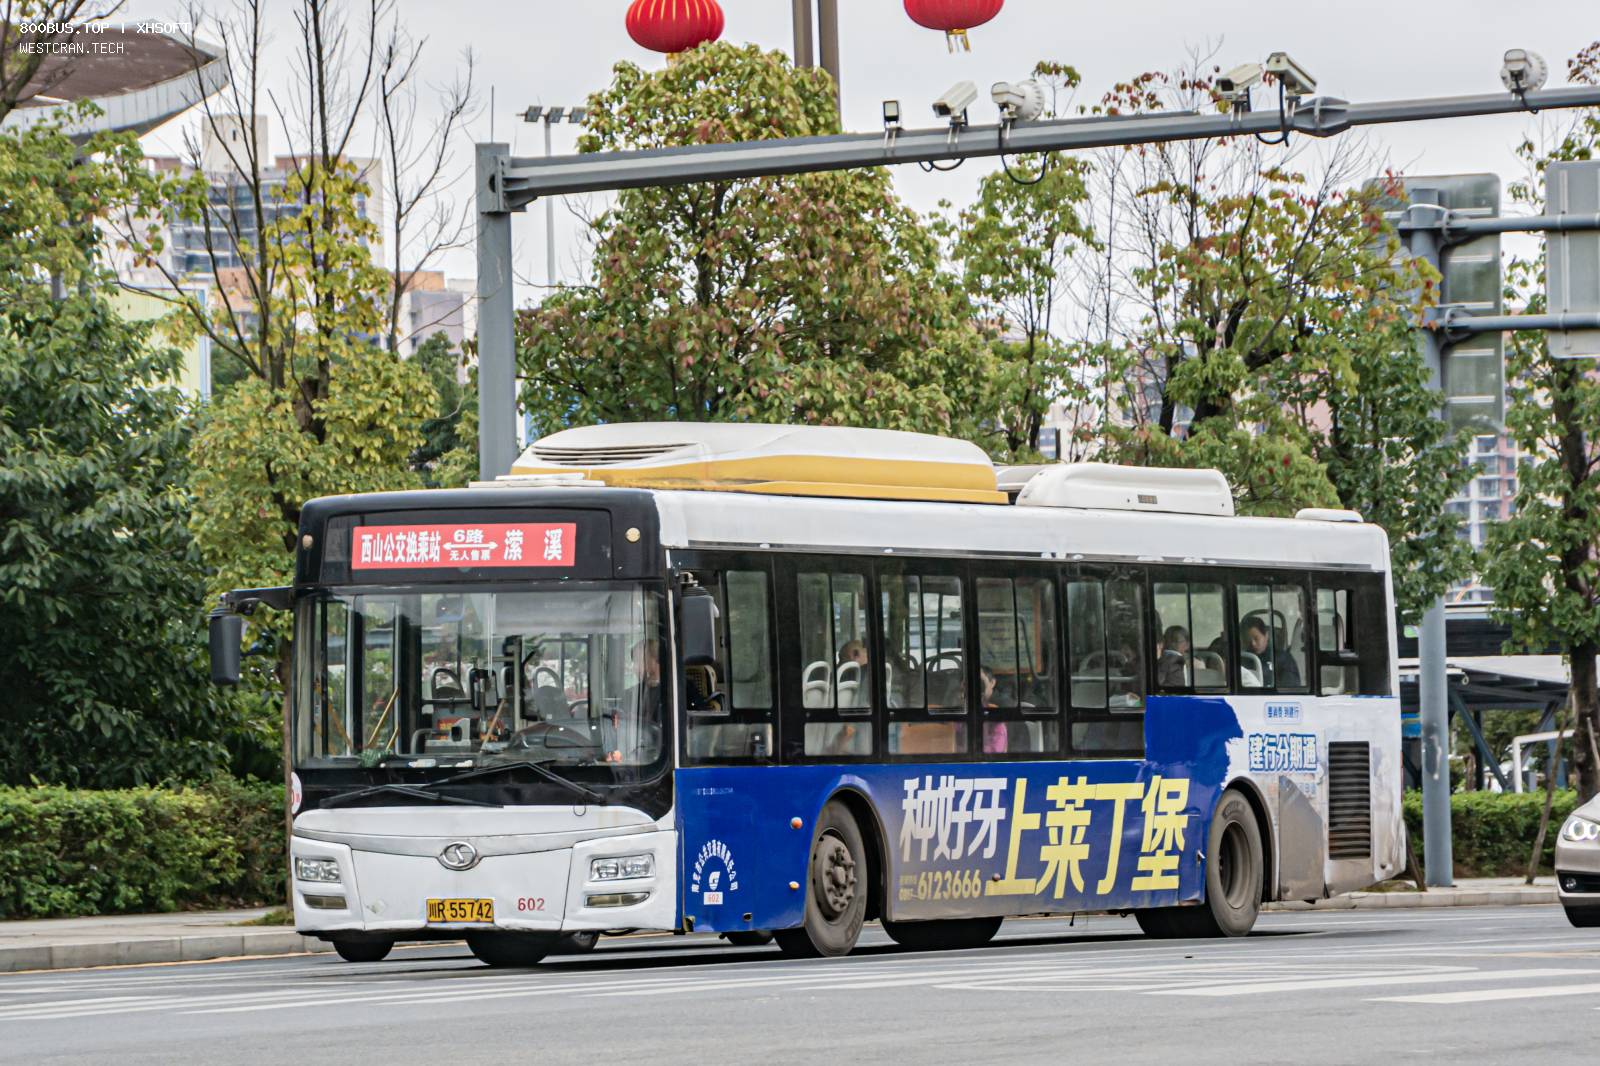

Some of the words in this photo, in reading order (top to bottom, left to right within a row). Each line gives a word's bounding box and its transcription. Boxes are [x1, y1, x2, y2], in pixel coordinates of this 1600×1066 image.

[360, 531, 441, 563] 西山公交换乘站
[453, 528, 484, 543] 6路
[449, 549, 491, 561] 无人售票
[1248, 733, 1318, 771] 建行分期通
[899, 775, 1008, 863] 种好牙
[984, 775, 1191, 900] 上莱丁堡
[917, 869, 982, 901] 6123666
[517, 897, 545, 912] 602
